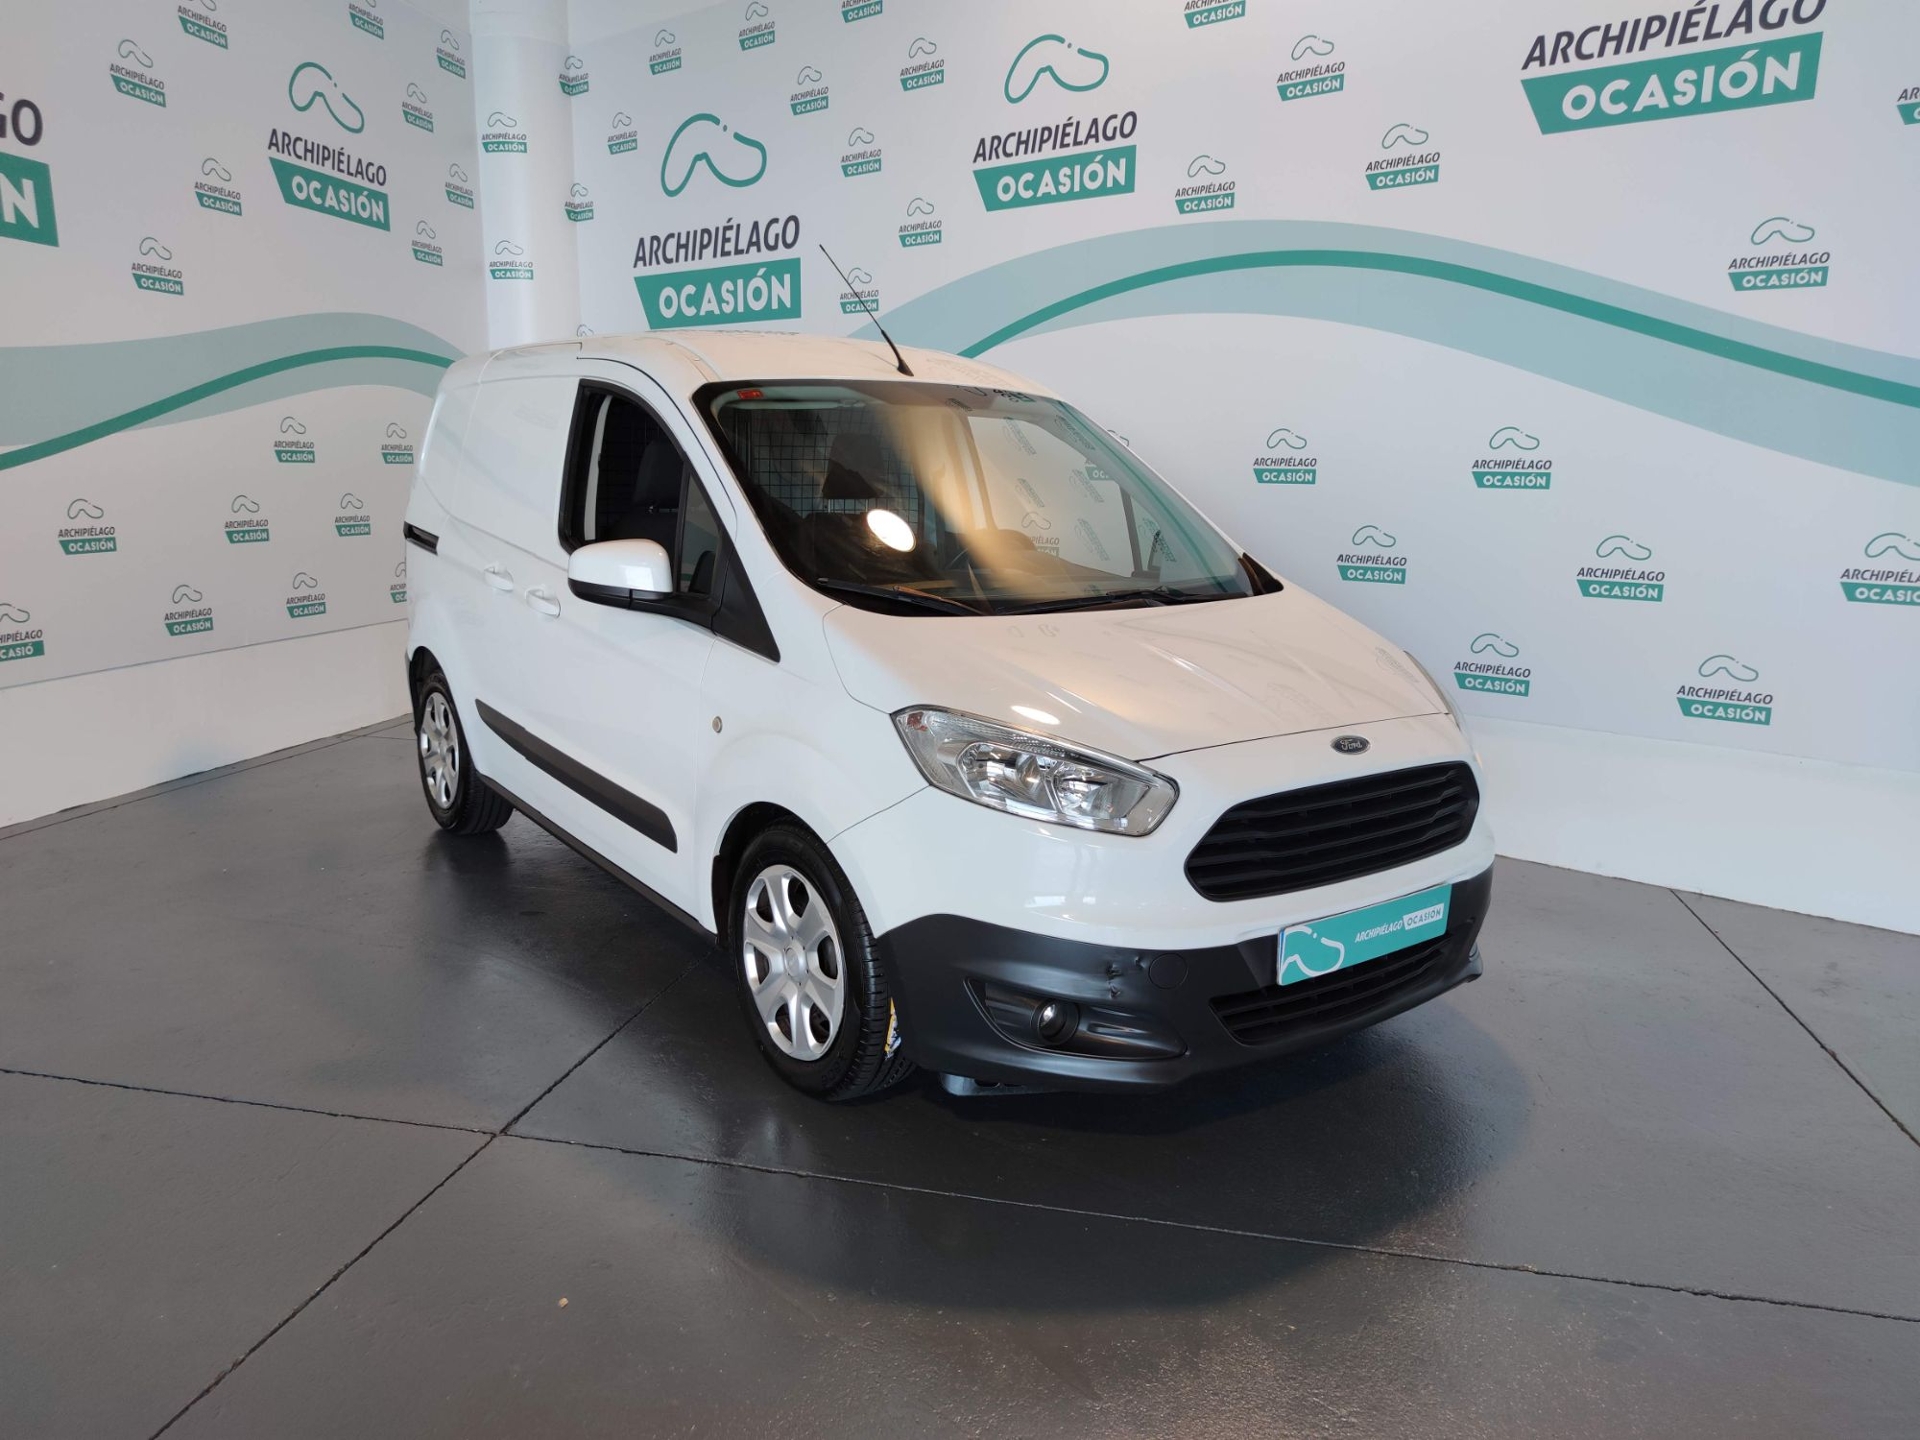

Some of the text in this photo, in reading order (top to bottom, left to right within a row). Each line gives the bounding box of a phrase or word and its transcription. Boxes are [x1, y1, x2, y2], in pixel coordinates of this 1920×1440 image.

[178, 5, 227, 32] ARCHIPIÉLAGO
[1193, 4, 1242, 24] OCASIÓN
[187, 23, 227, 47] OCASIÓN
[1522, 0, 1826, 70] ARCHIPIÉLAGO
[110, 64, 164, 90] ARCHIPIÉLAGO
[901, 59, 944, 79] ARCHIPIÉLAGO
[1277, 62, 1345, 83] ARCHIPIÉLAGO
[906, 73, 943, 89] OCASIÓN
[1286, 77, 1341, 98] OCASIÓN
[1562, 49, 1801, 120] OCASIÓN
[120, 80, 164, 105] OCASIÓN
[482, 133, 526, 141] ARCHIPIÉLAGO
[973, 111, 1137, 162] ARCHIPIÉLAGO
[487, 142, 524, 152] OCASIÓN
[268, 129, 386, 186] ARCHIPIÉLAGO
[841, 149, 881, 163] ARCHIPIÉLAGO
[1366, 152, 1440, 172] ARCHIPIÉLAGO
[847, 159, 880, 173] OCASIÓN
[996, 155, 1126, 202] OCASIÓN
[1376, 167, 1435, 186] OCASIÓN
[195, 181, 241, 200] ARCHIPIÉLAGO
[1175, 181, 1235, 197] ARCHIPIÉLAGO
[203, 195, 239, 214] OCASIÓN
[292, 175, 384, 223] OCASIÓN
[1183, 195, 1232, 212] OCASIÓN
[899, 221, 941, 234] ARCHIPIÉLAGO
[633, 215, 799, 268] ARCHIPIÉLAGO
[905, 230, 940, 245] OCASIÓN
[1728, 252, 1829, 270] ARCHIPIÉLAGO
[132, 263, 182, 279] ARCHIPIÉLAGO
[495, 270, 532, 279] OCASIÓN
[1742, 269, 1822, 287] OCASIÓN
[141, 277, 182, 293] OCASIÓN
[658, 271, 791, 318] OCASIÓN
[274, 441, 314, 449] ARCHIPIÉLAGO
[281, 452, 314, 461] OCASIÓN
[1253, 457, 1317, 468] ARCHIPIÉLAGO
[1472, 458, 1552, 470] ARCHIPIÉLAGO
[1262, 469, 1313, 483] OCASIÓN
[1483, 473, 1547, 487] OCASIÓN
[59, 527, 115, 538] ARCHIPIÉLAGO
[225, 520, 269, 530] ARCHIPIÉLAGO
[233, 530, 268, 541] OCASIÓN
[68, 540, 114, 552] OCASIÓN
[1337, 554, 1407, 566] ARCHIPIÉLAGO
[1346, 567, 1403, 583] OCASIÓN
[1577, 567, 1665, 582] ARCHIPIÉLAGO
[1589, 583, 1659, 599] OCASIÓN
[165, 608, 212, 620] ARCHIPIÉLAGO
[173, 620, 211, 633] OCASIÓN
[1454, 661, 1531, 678] ARCHIPIÉLAGO
[1464, 676, 1526, 694] OCASIÓN
[1677, 685, 1772, 705] ARCHIPIÉLAGO
[1690, 702, 1767, 721] OCASIÓN
[1407, 907, 1441, 926] OCASIÓN
